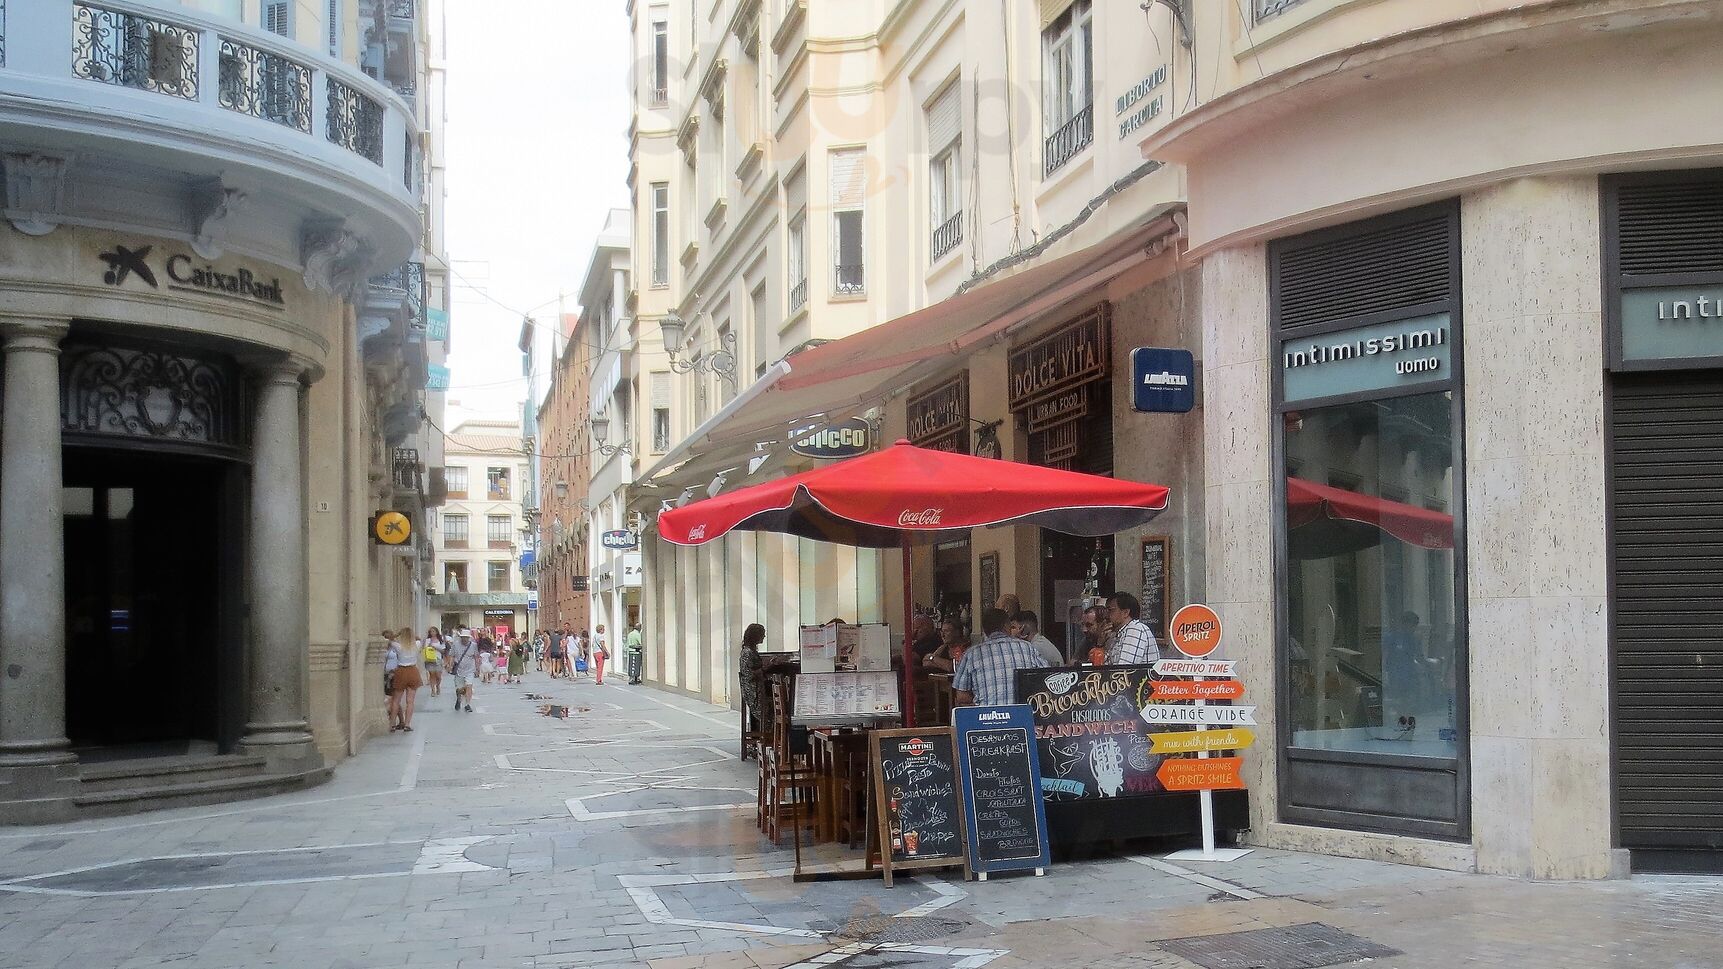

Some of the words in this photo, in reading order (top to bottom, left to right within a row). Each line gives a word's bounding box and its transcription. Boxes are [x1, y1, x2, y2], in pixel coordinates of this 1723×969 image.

[1114, 64, 1166, 117] LIBORIO
[167, 254, 285, 304] CaixaBank
[1285, 327, 1445, 368] intimissimi
[1015, 356, 1056, 400] DOLCE
[1061, 341, 1095, 377] VITA
[1395, 356, 1439, 374] uomo
[1143, 371, 1188, 385] LAVAZZA
[910, 409, 936, 439] DOLCE
[1177, 620, 1215, 635] APEROL
[1183, 631, 1209, 642] SPRITZ
[1160, 662, 1205, 673] APERITIVO
[1208, 663, 1229, 673] TIME
[1027, 669, 1137, 718] Breakfast
[1157, 684, 1188, 695] Better
[1191, 683, 1235, 698] Together
[978, 710, 1010, 721] LAVAZZA
[1071, 709, 1112, 723] ENSALADAS
[1148, 708, 1204, 720] ORANGE
[1215, 709, 1246, 721] VIBE
[1034, 719, 1137, 739] SANDWICH
[1183, 735, 1203, 747] with
[1205, 733, 1239, 750] friends
[1041, 780, 1077, 792] ocktail
[1168, 776, 1175, 786] A
[1177, 774, 1205, 785] SPRITZ
[1207, 773, 1232, 784] SMILE
